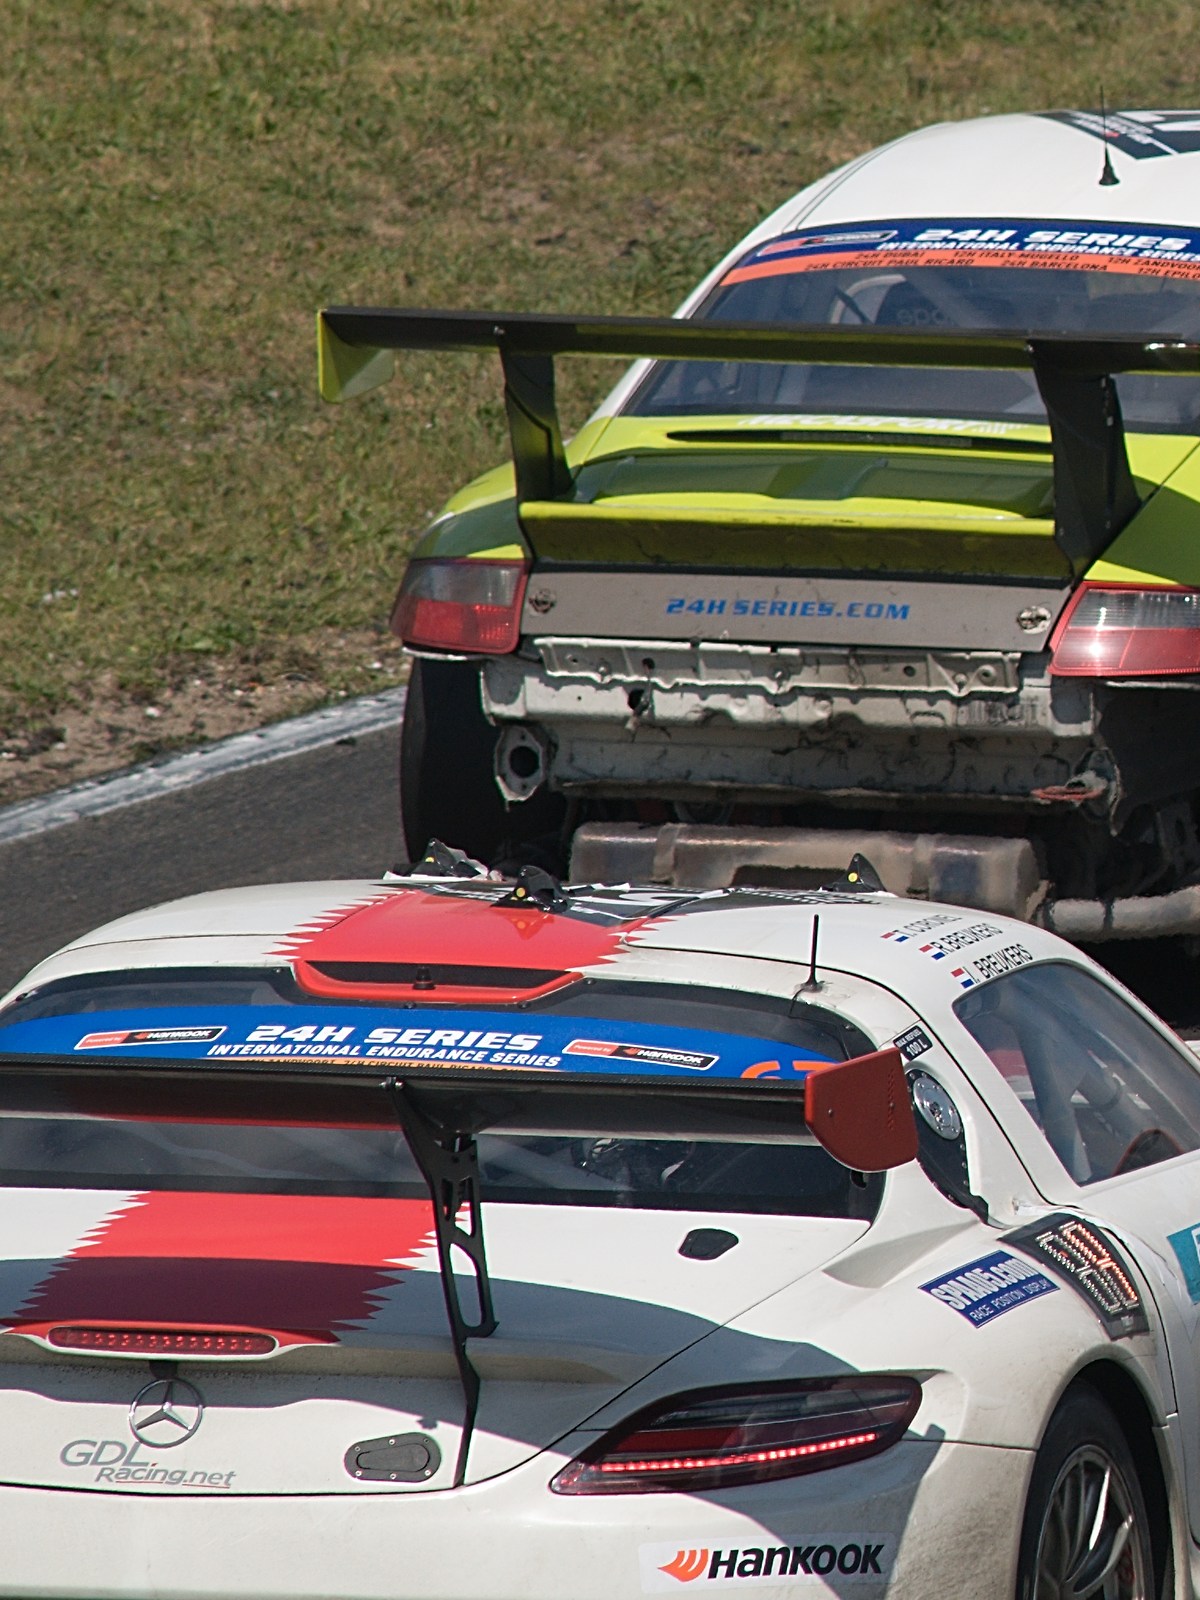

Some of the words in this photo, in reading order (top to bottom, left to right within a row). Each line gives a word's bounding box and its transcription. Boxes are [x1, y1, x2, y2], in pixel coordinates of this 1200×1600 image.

[876, 241, 1020, 251] INTERNATIONAL
[1023, 242, 1139, 257] ENDURANCE
[914, 228, 1018, 242] 24H
[1023, 230, 1192, 251] SERIES
[887, 258, 919, 267] PAUL
[924, 258, 975, 266] RICARD
[1030, 260, 1108, 272] BARCELONA
[666, 598, 727, 615] 24H
[732, 600, 911, 621] SERIES.COM
[973, 943, 1034, 980] BREUKERS
[246, 1025, 356, 1043] 24H
[364, 1027, 543, 1052] SERIES
[906, 1041, 922, 1056] 100
[207, 1044, 362, 1057] INTERNATIONAL
[365, 1046, 490, 1062] ENDURANCE
[490, 1052, 562, 1068] SERIES
[969, 1304, 994, 1321] RACE
[994, 1289, 1025, 1310] POSITION
[1023, 1279, 1052, 1296] DISPLAY
[60, 1438, 151, 1467] GDL
[95, 1465, 237, 1487] Racing.net
